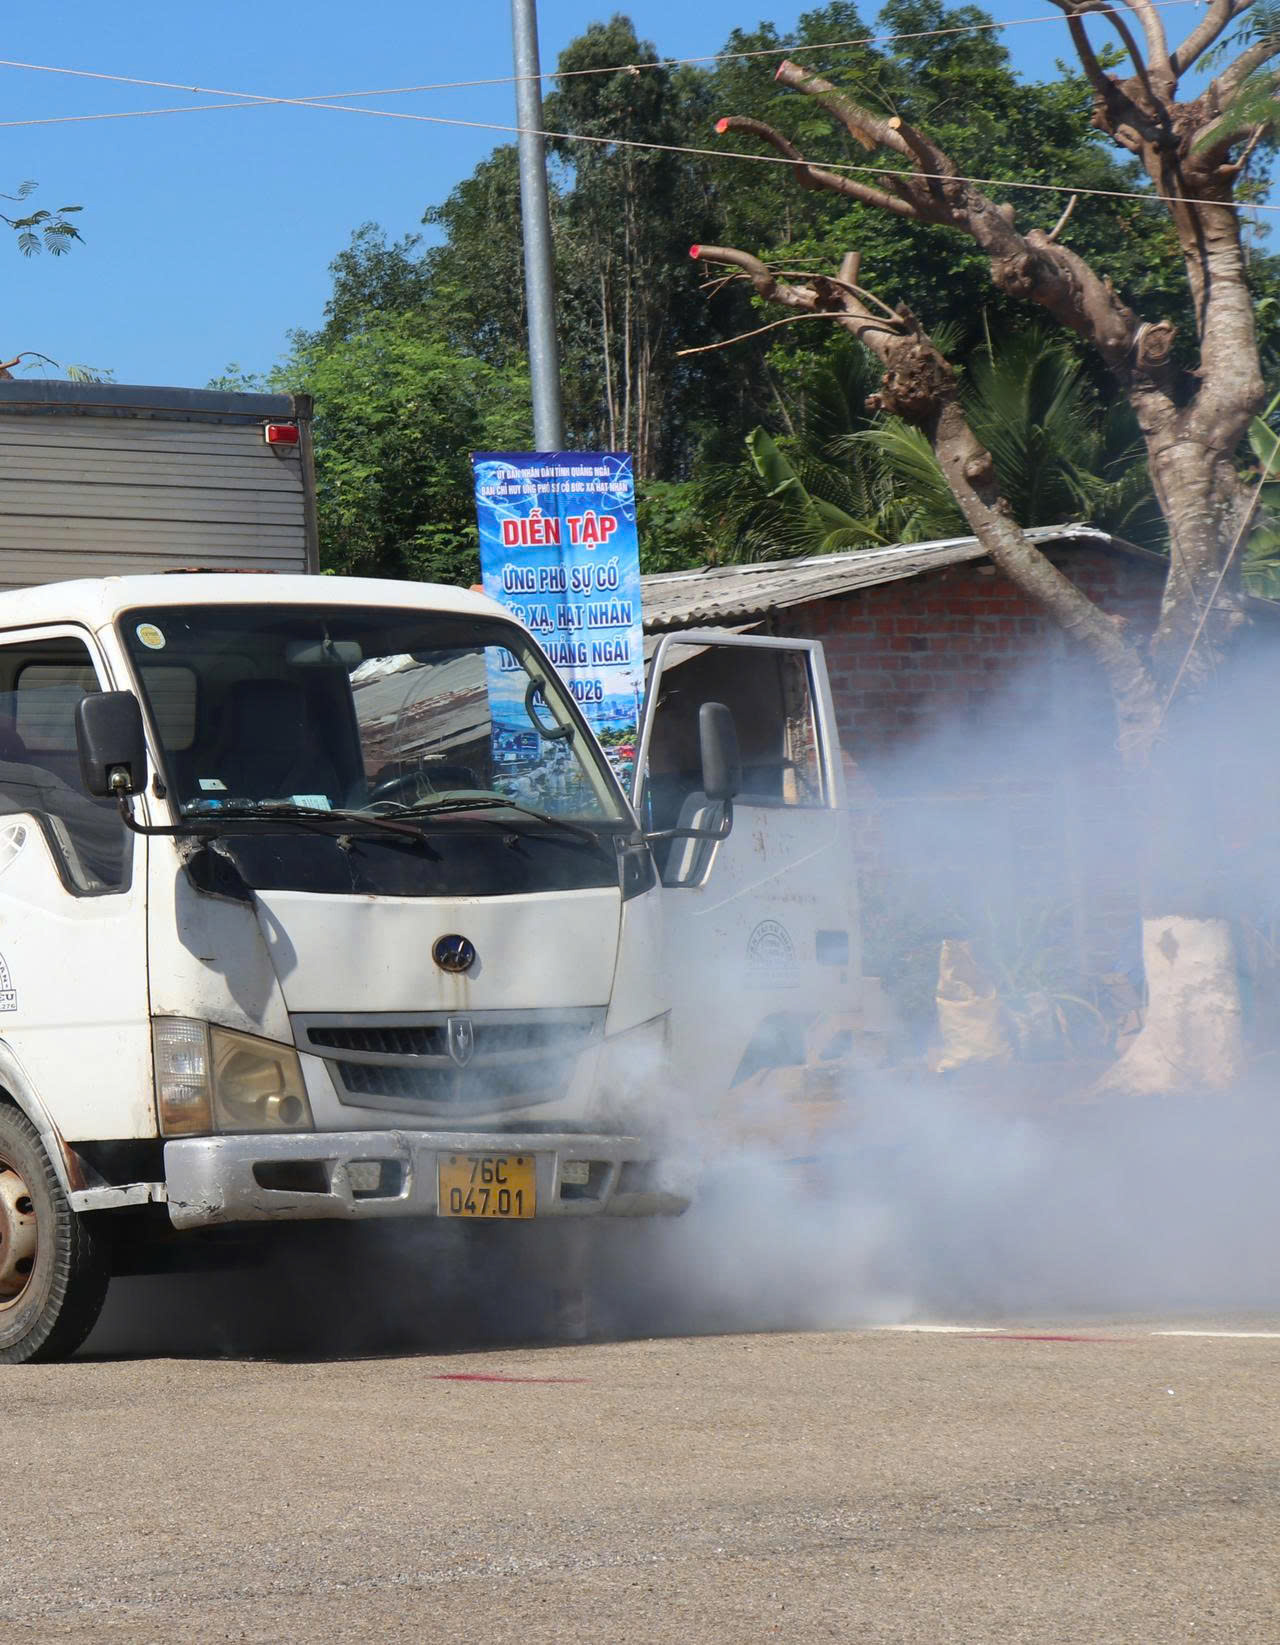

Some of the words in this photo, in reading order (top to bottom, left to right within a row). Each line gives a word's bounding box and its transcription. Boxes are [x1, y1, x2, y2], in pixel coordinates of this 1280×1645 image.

[508, 484, 521, 495] HUY
[502, 508, 561, 547] DIỄN
[567, 510, 617, 549] TẬP
[503, 564, 537, 592] ỨNG
[539, 562, 568, 592] PHÓ
[571, 563, 595, 595] SỰ
[596, 556, 619, 590] CỐ
[557, 604, 585, 634] HẠT
[587, 598, 633, 628] NHÂN
[592, 636, 630, 665] NGÃI
[467, 1157, 508, 1184] 76C
[450, 1187, 523, 1215] 047.01
